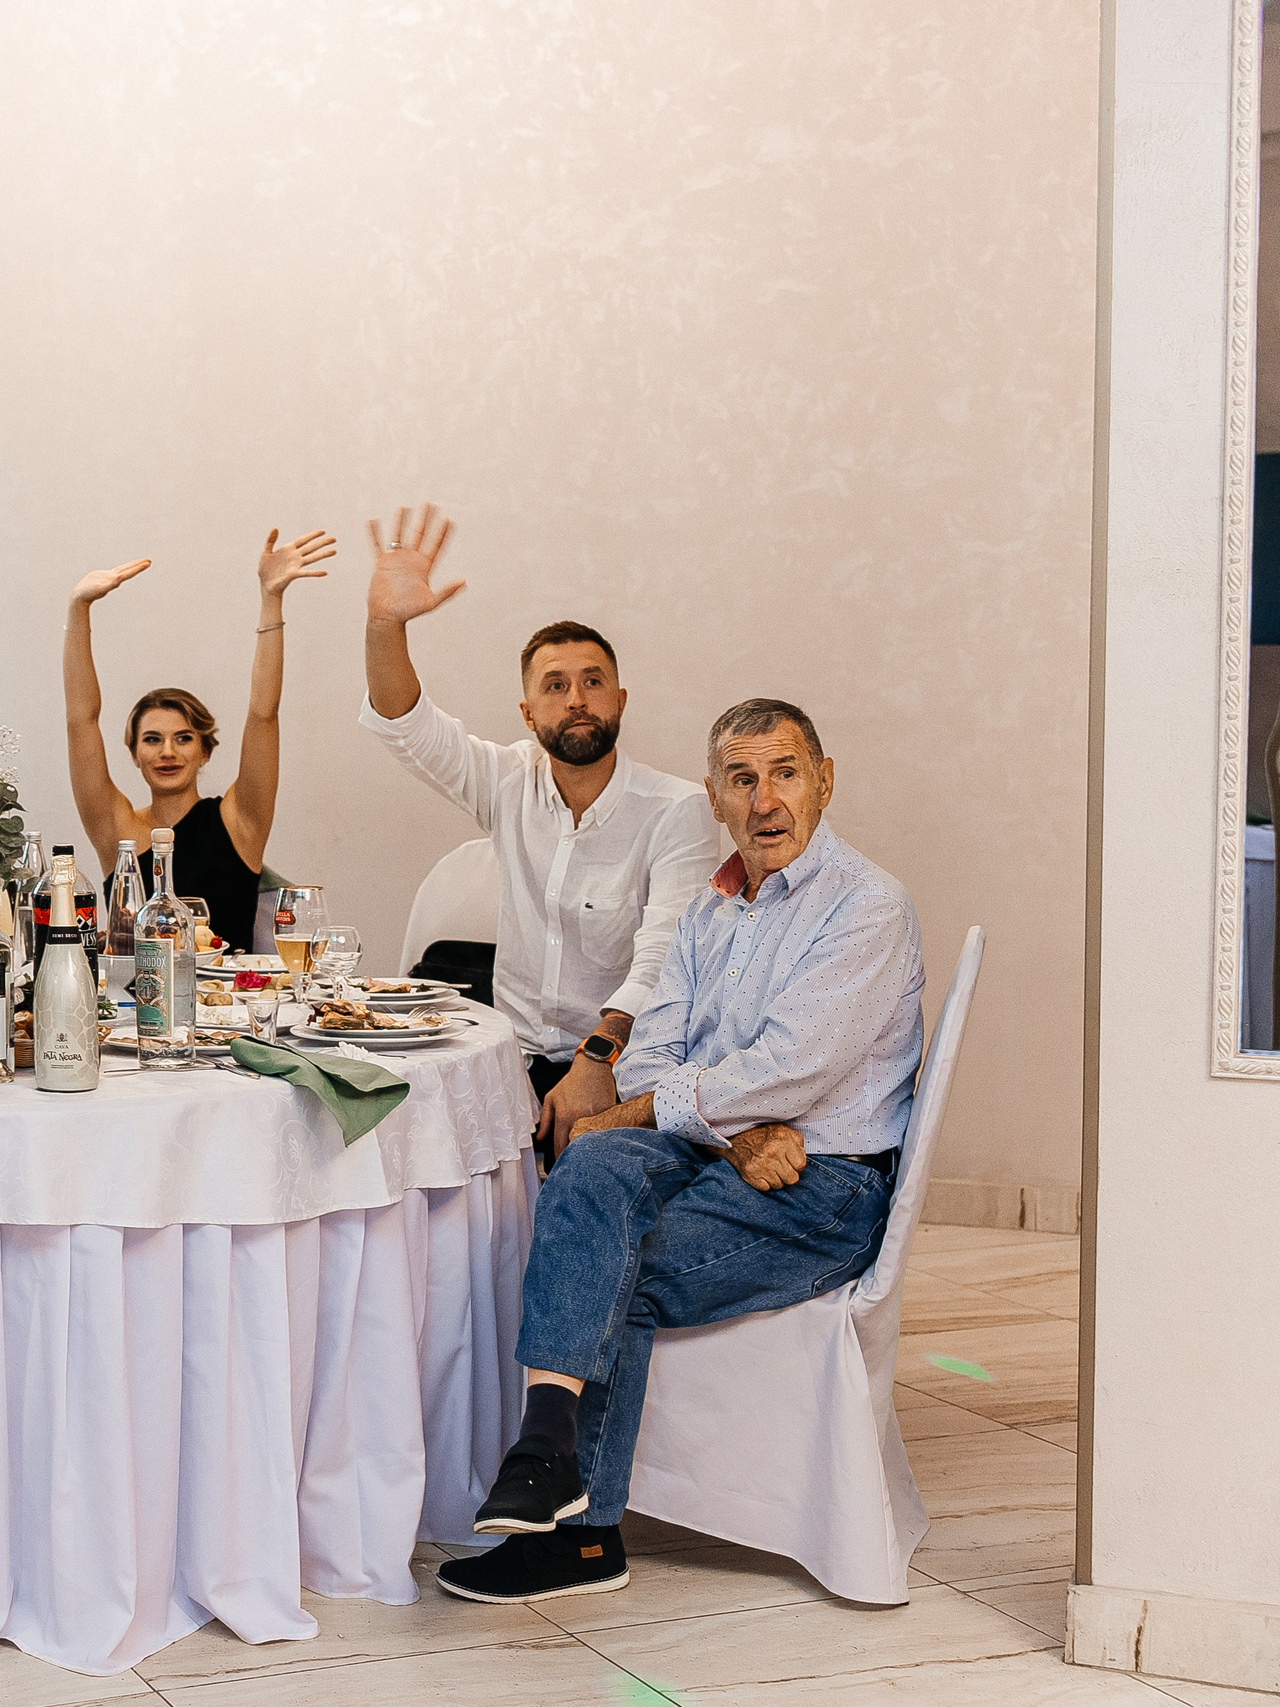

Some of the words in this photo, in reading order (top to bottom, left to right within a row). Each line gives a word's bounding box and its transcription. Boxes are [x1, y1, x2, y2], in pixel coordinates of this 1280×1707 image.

[80, 931, 97, 947] VESS
[43, 1051, 58, 1060] PATA
[59, 1051, 83, 1062] NEGRA
